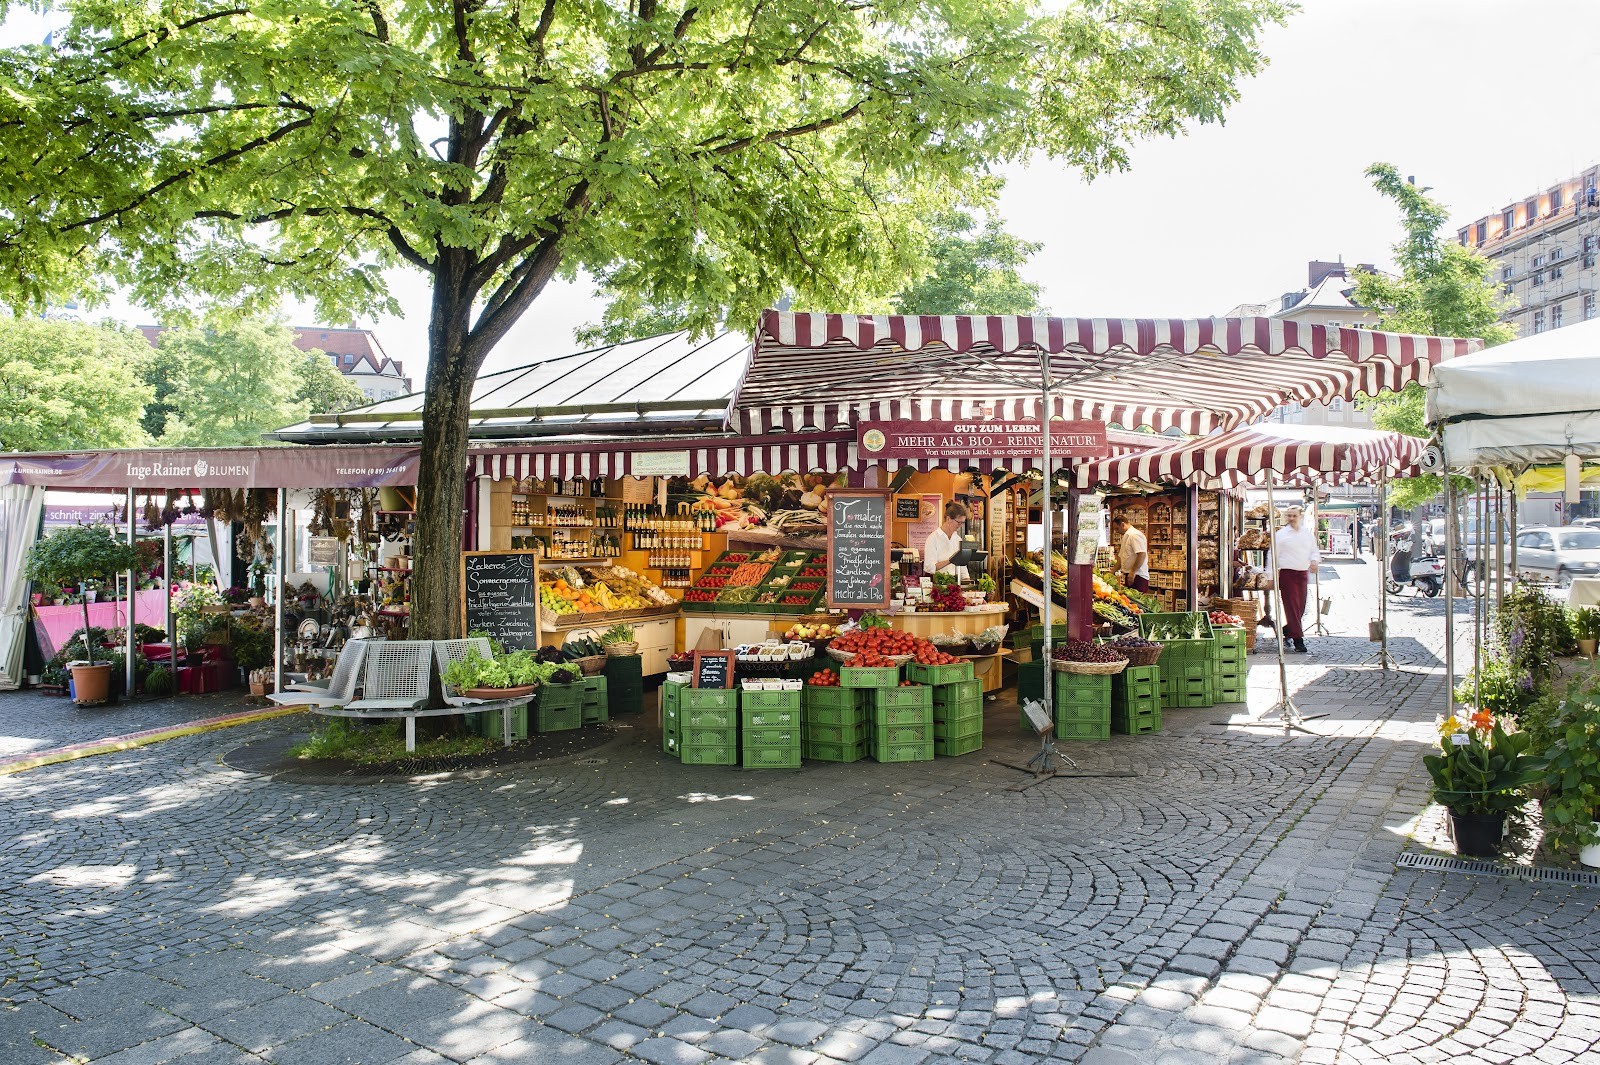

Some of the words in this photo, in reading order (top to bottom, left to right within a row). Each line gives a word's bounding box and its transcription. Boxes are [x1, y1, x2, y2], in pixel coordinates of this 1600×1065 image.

[954, 424, 977, 432] GUT
[979, 424, 1002, 432] ZUM
[1005, 424, 1040, 432] LEBEN
[898, 436, 936, 446] MEHR
[941, 436, 964, 446] ALS
[968, 436, 992, 446] BIO
[1008, 436, 1044, 446] REINE
[1050, 436, 1096, 446] NATUR!
[126, 463, 151, 480] Inge
[153, 463, 192, 476] Rainer
[210, 466, 248, 476] BLUMEN
[50, 510, 82, 520] schnitt
[834, 500, 882, 525] Tomaten
[834, 529, 857, 539] Tomaten
[859, 530, 884, 538] schmecken
[467, 558, 506, 570] Leckeres
[838, 552, 880, 569] Friedfertigen
[468, 572, 530, 592] Sommergemüse
[835, 587, 855, 598] mehr
[857, 586, 868, 599] als
[868, 587, 883, 600] Bio
[470, 618, 496, 628] Gurken
[500, 628, 533, 641] Aubergine
